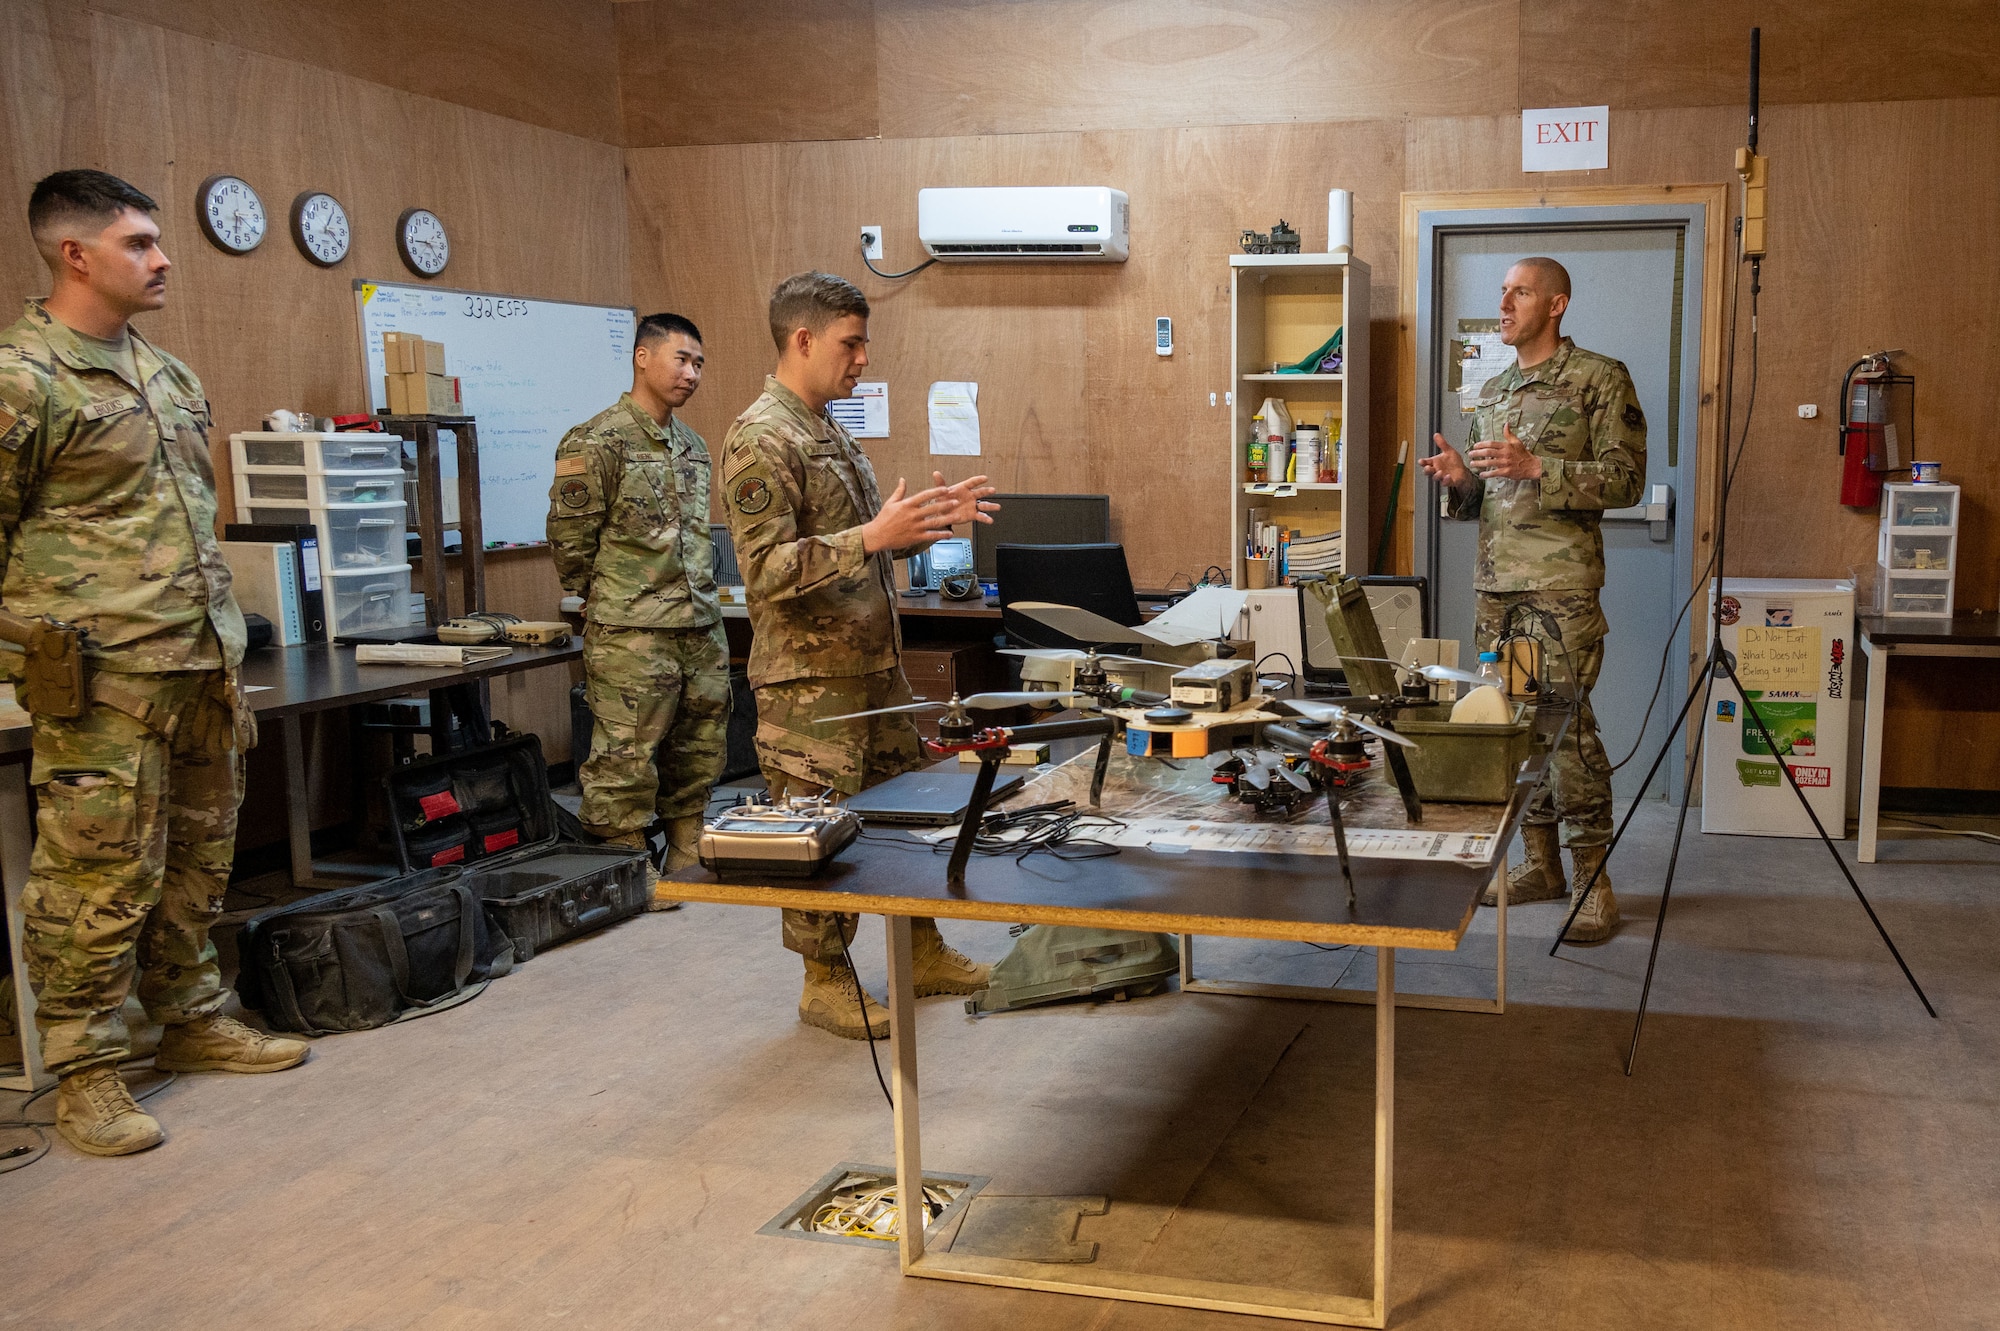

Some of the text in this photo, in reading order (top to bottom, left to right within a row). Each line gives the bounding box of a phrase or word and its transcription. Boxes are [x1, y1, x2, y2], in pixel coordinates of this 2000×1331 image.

[1536, 121, 1599, 145] EXIT
[231, 184, 239, 194] 12
[321, 201, 328, 209] 12
[212, 207, 218, 216] 9
[253, 214, 259, 222] 3
[217, 220, 223, 229] 8
[305, 222, 310, 230] 9
[225, 230, 231, 238] 7
[244, 233, 250, 241] 5
[235, 235, 241, 244] 6
[94, 400, 124, 416] BROOKS
[1746, 628, 1808, 643] Do Not Eat
[1742, 649, 1808, 660] What Does Not
[1743, 662, 1769, 680] Belong
[1827, 664, 1844, 698] INSANE
[1758, 736, 1784, 744] Loger
[1795, 768, 1828, 778] ONLY IN
[1795, 777, 1828, 785] BOZEMAN
